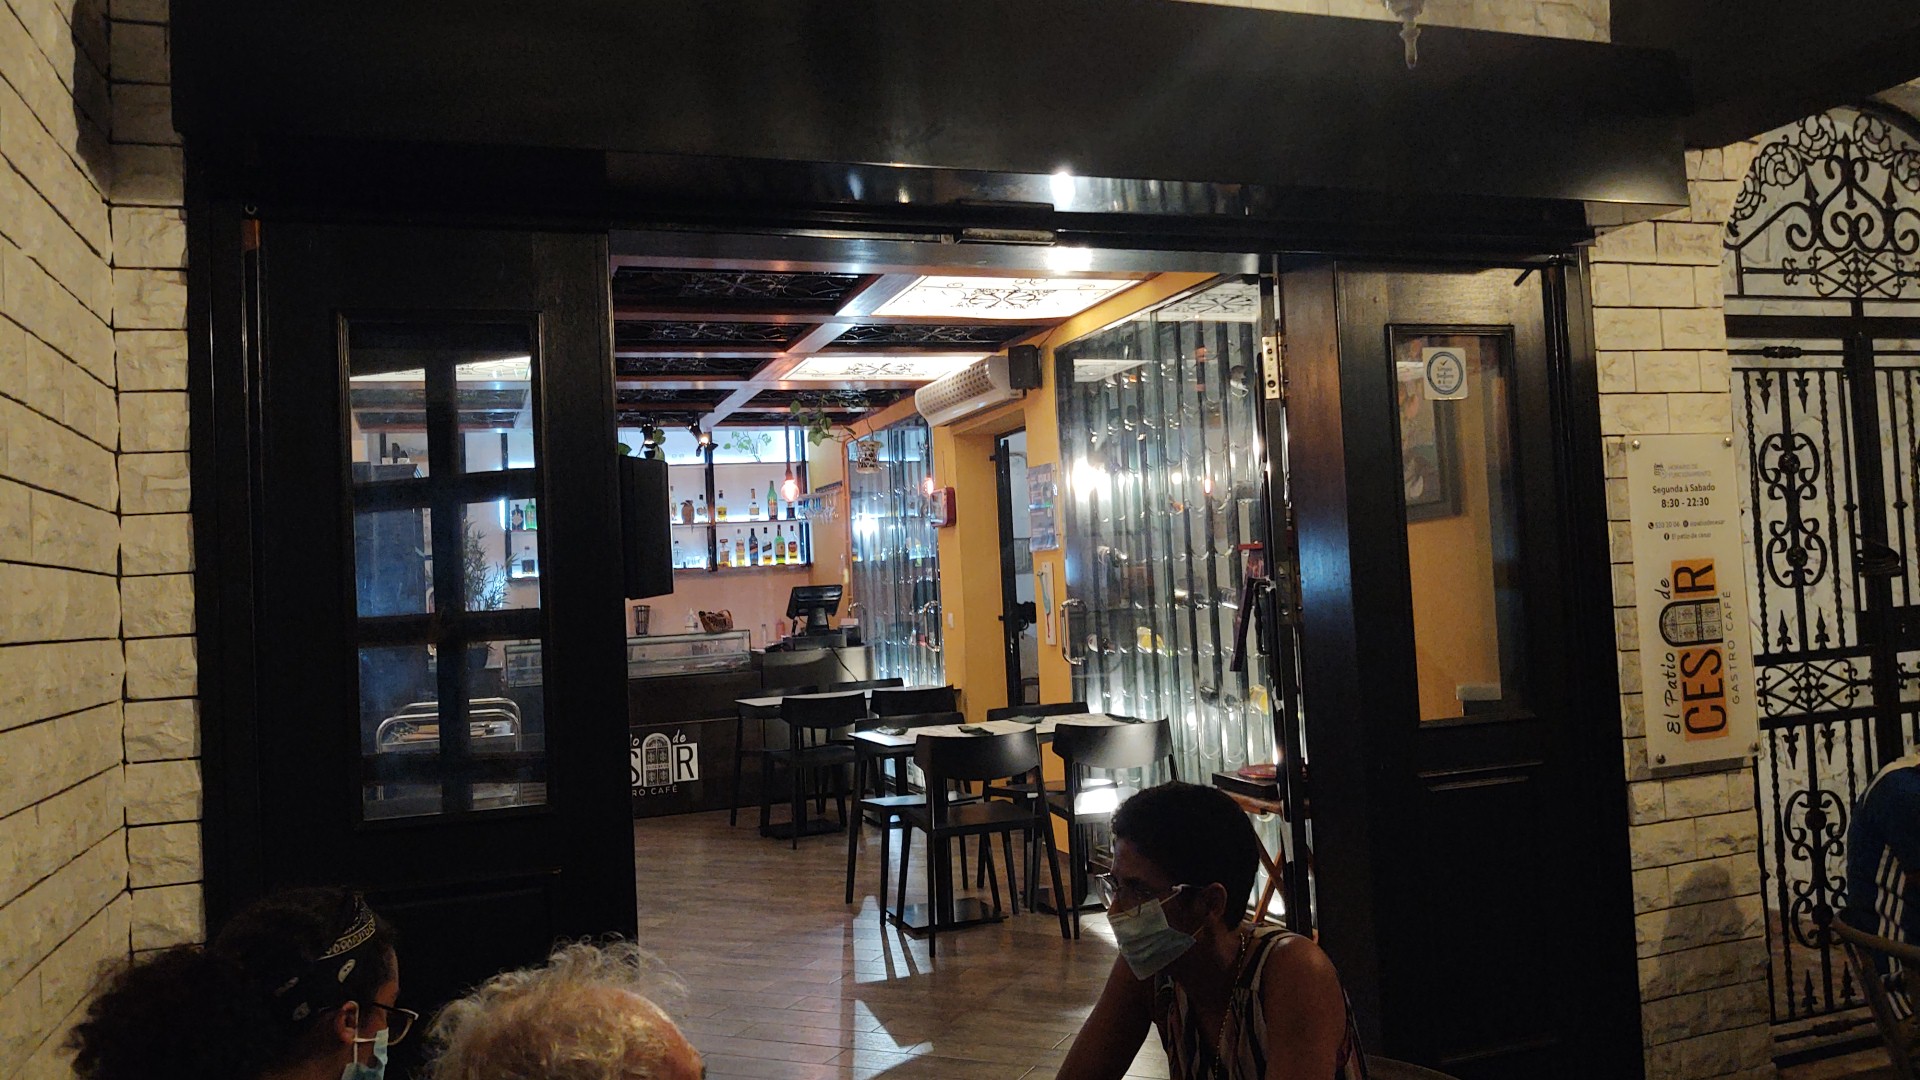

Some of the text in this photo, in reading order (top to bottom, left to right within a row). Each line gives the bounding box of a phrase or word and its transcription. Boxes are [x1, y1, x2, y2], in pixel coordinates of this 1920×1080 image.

[1652, 484, 1683, 496] Segunda
[1689, 483, 1716, 492] Sabado
[1661, 498, 1680, 509] 8:30
[1686, 496, 1710, 507] 22:30
[1654, 577, 1681, 735] El Patio de
[1727, 640, 1740, 705] GASTRO
[672, 729, 687, 743] de
